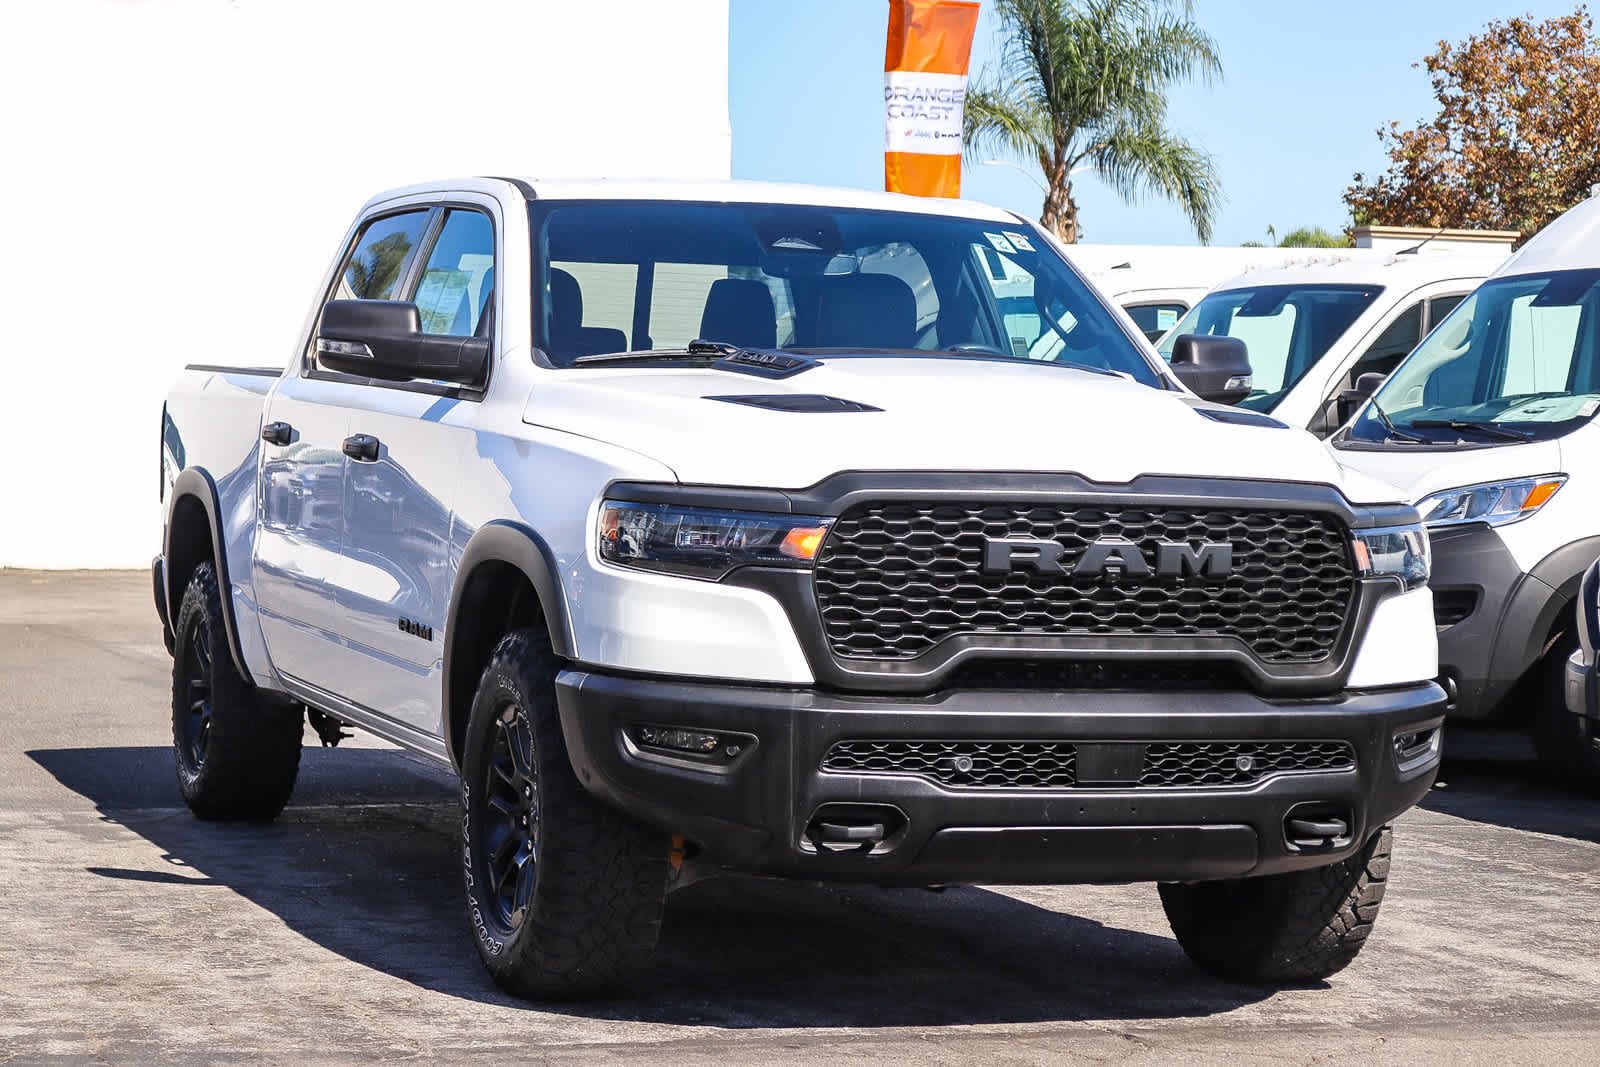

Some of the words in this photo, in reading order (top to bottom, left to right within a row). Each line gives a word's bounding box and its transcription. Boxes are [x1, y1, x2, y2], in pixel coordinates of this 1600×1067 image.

[887, 104, 953, 120] COAST
[983, 537, 1233, 577] RAM
[398, 616, 433, 642] RAM
